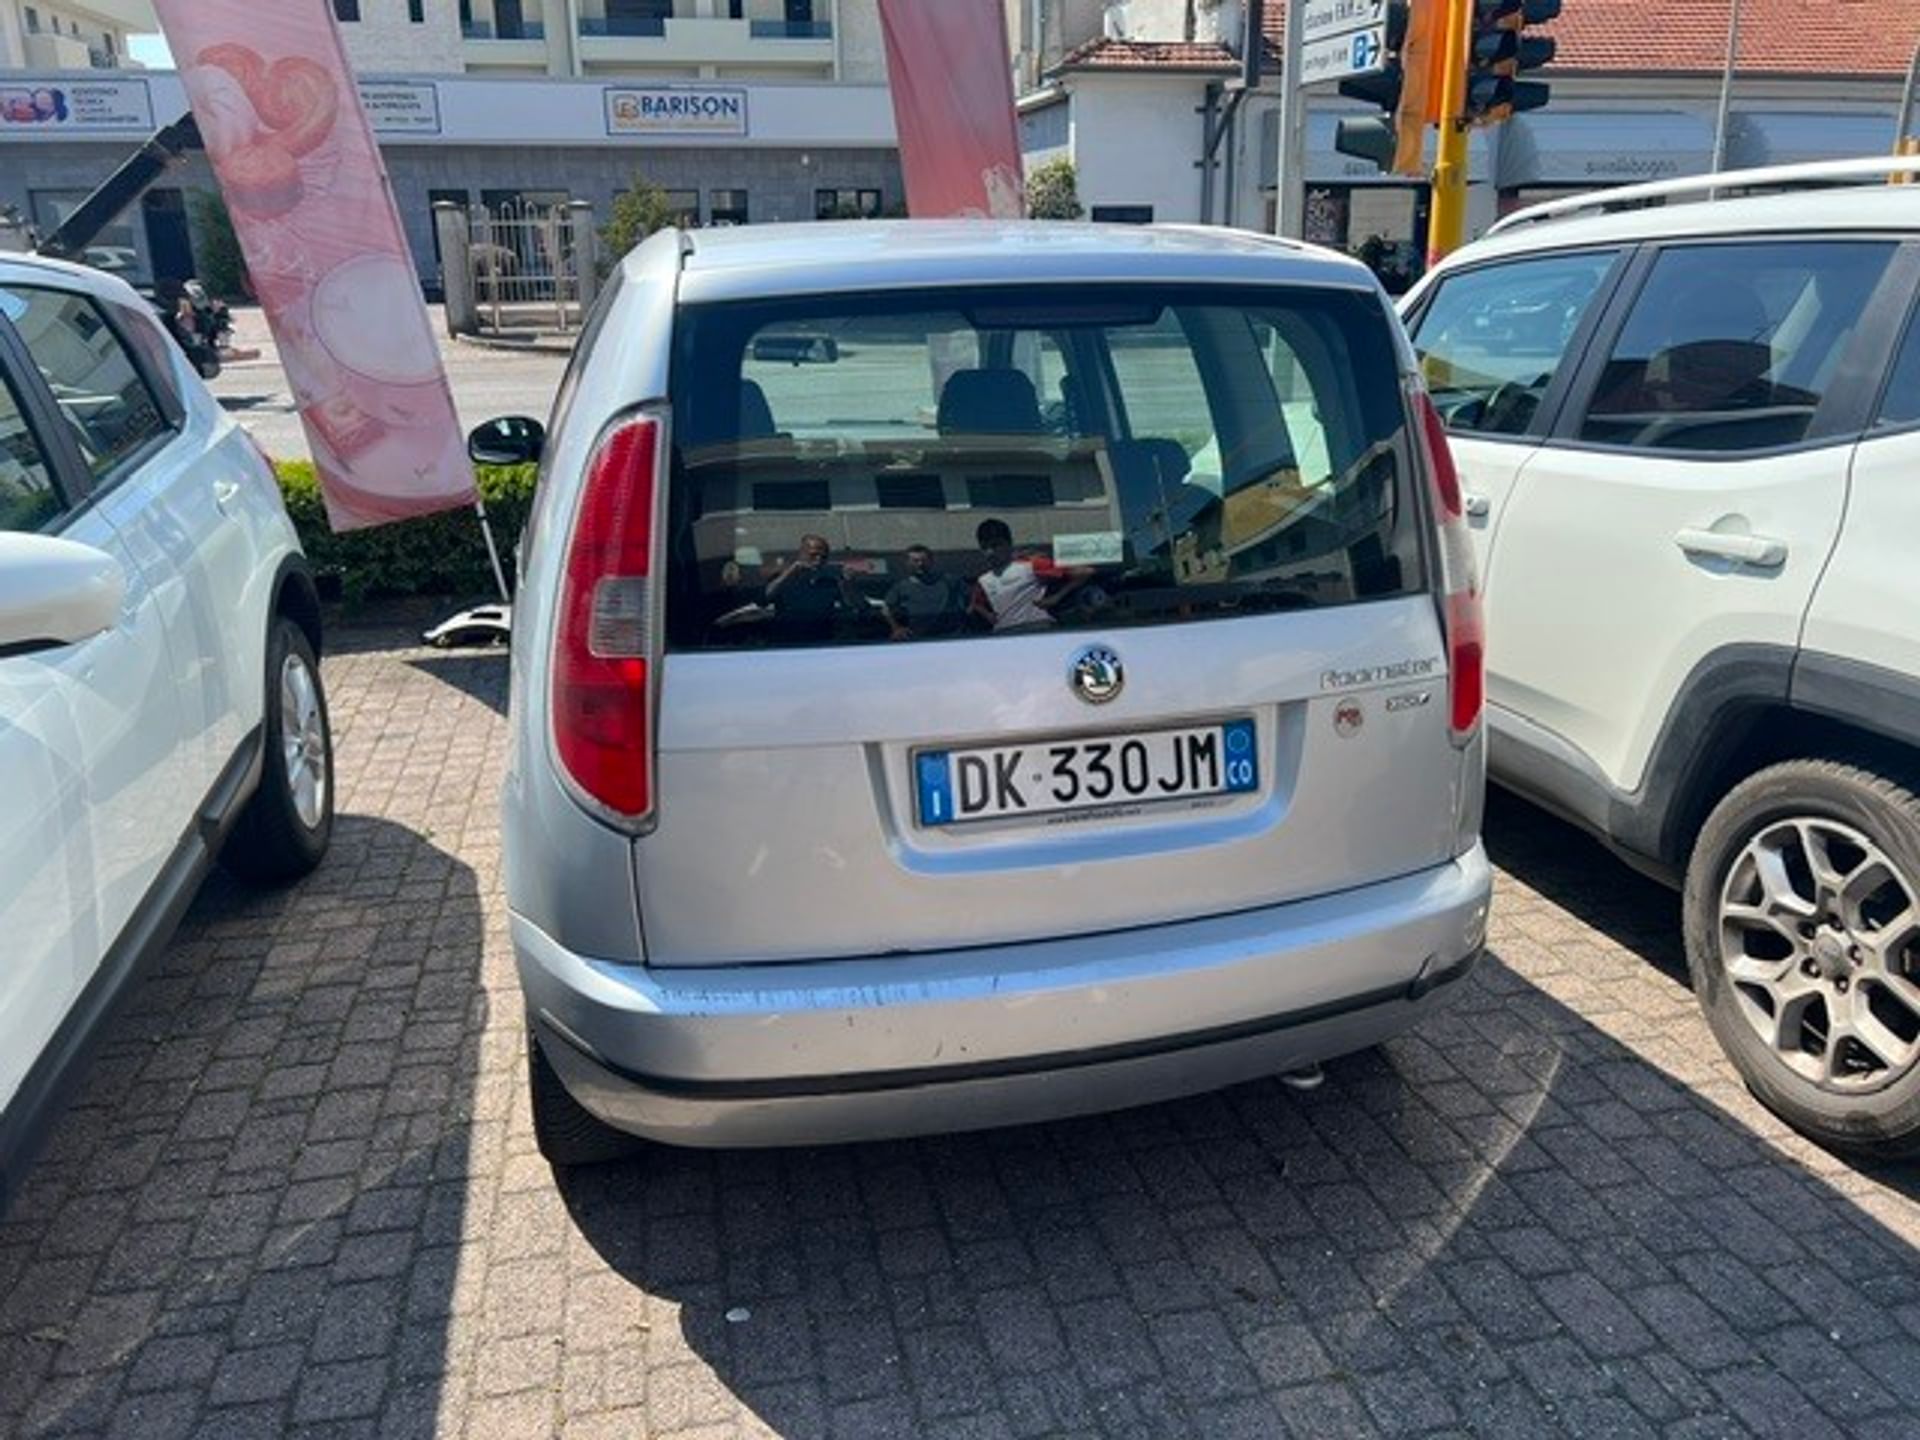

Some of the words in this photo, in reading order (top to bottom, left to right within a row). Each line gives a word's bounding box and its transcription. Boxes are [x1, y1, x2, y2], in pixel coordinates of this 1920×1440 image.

[641, 95, 738, 117] BARISON
[956, 751, 1026, 814] DK
[1227, 759, 1251, 785] CO
